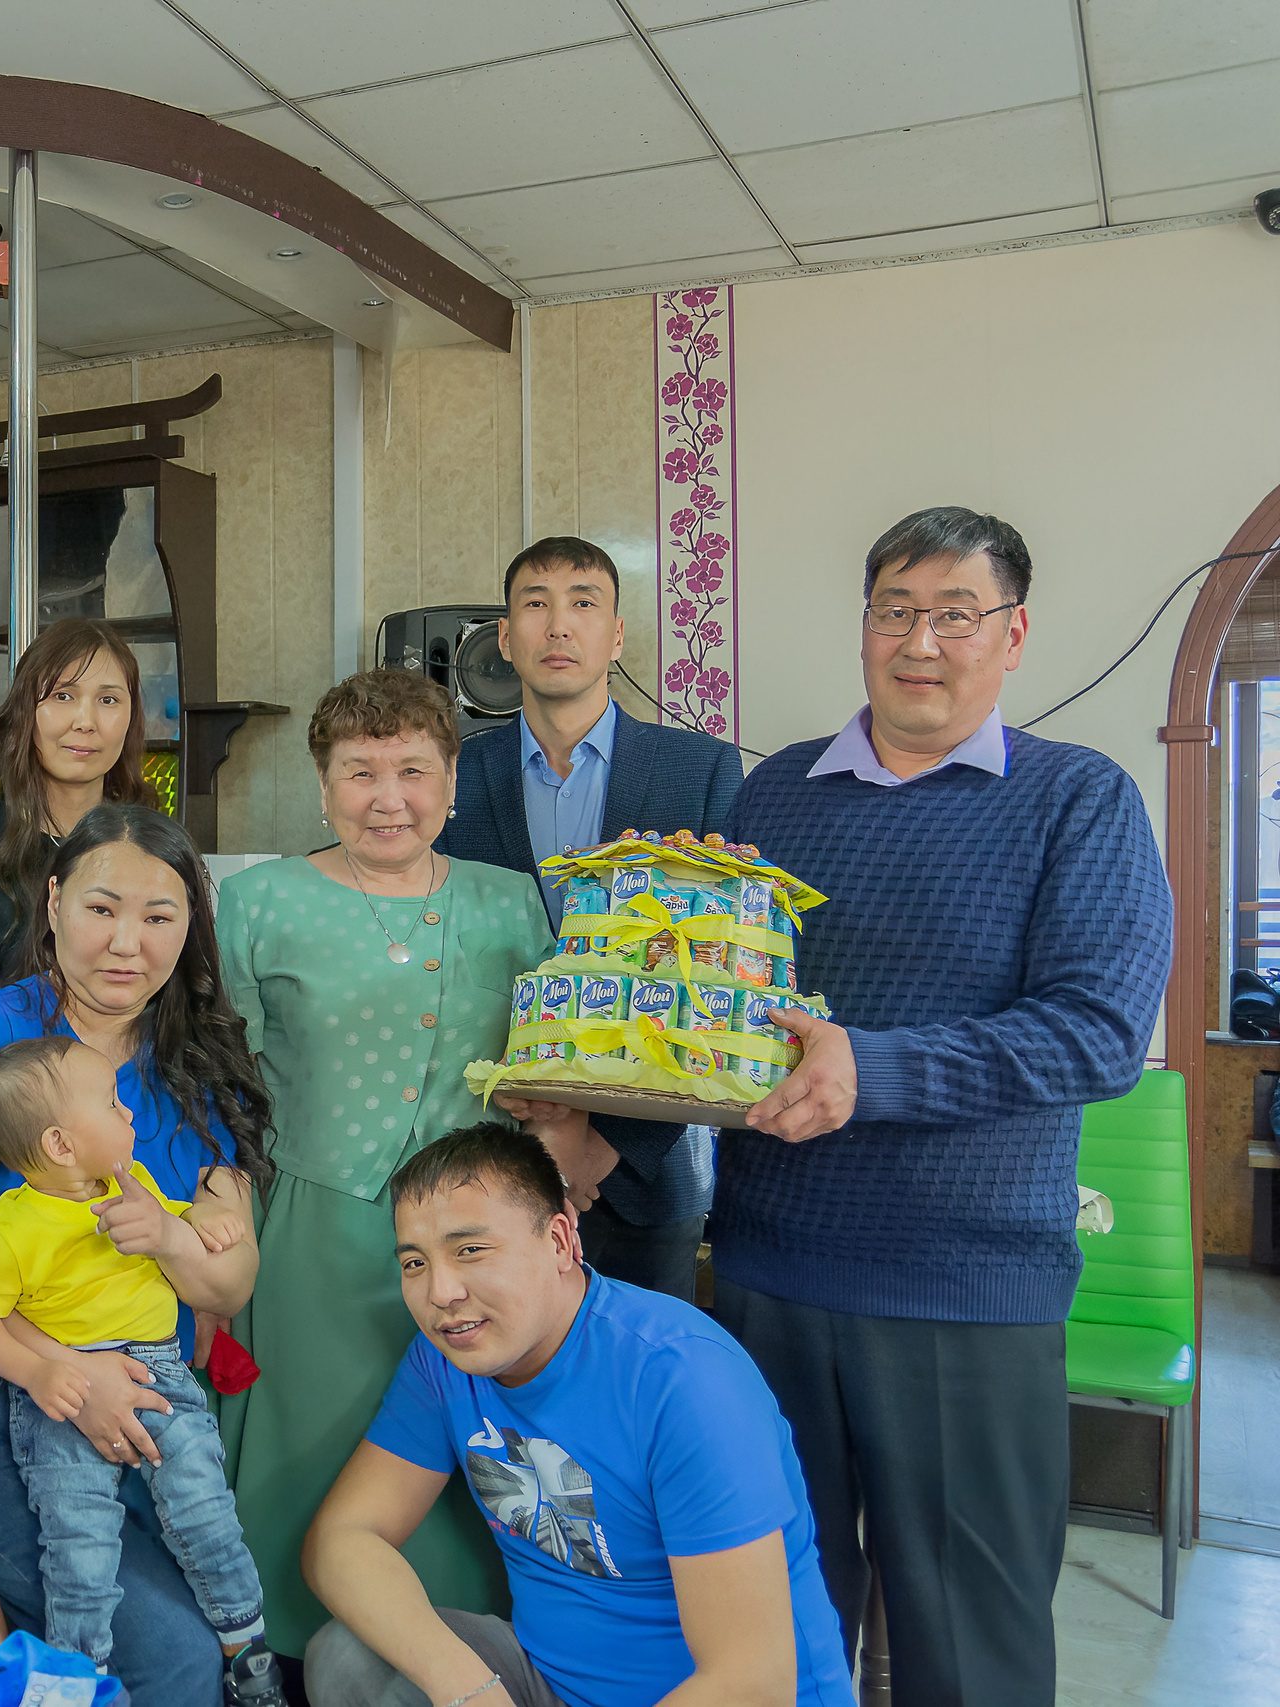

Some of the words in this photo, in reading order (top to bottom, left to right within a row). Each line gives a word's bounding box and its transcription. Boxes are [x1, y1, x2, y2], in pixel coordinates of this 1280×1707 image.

[614, 874, 646, 893] Мой
[742, 887, 769, 906] Мой
[543, 982, 569, 1001] Мой
[582, 983, 615, 1002] Мой
[634, 985, 671, 1006] Мой
[746, 1000, 769, 1020] Мо
[591, 1520, 623, 1578] DEMIX
